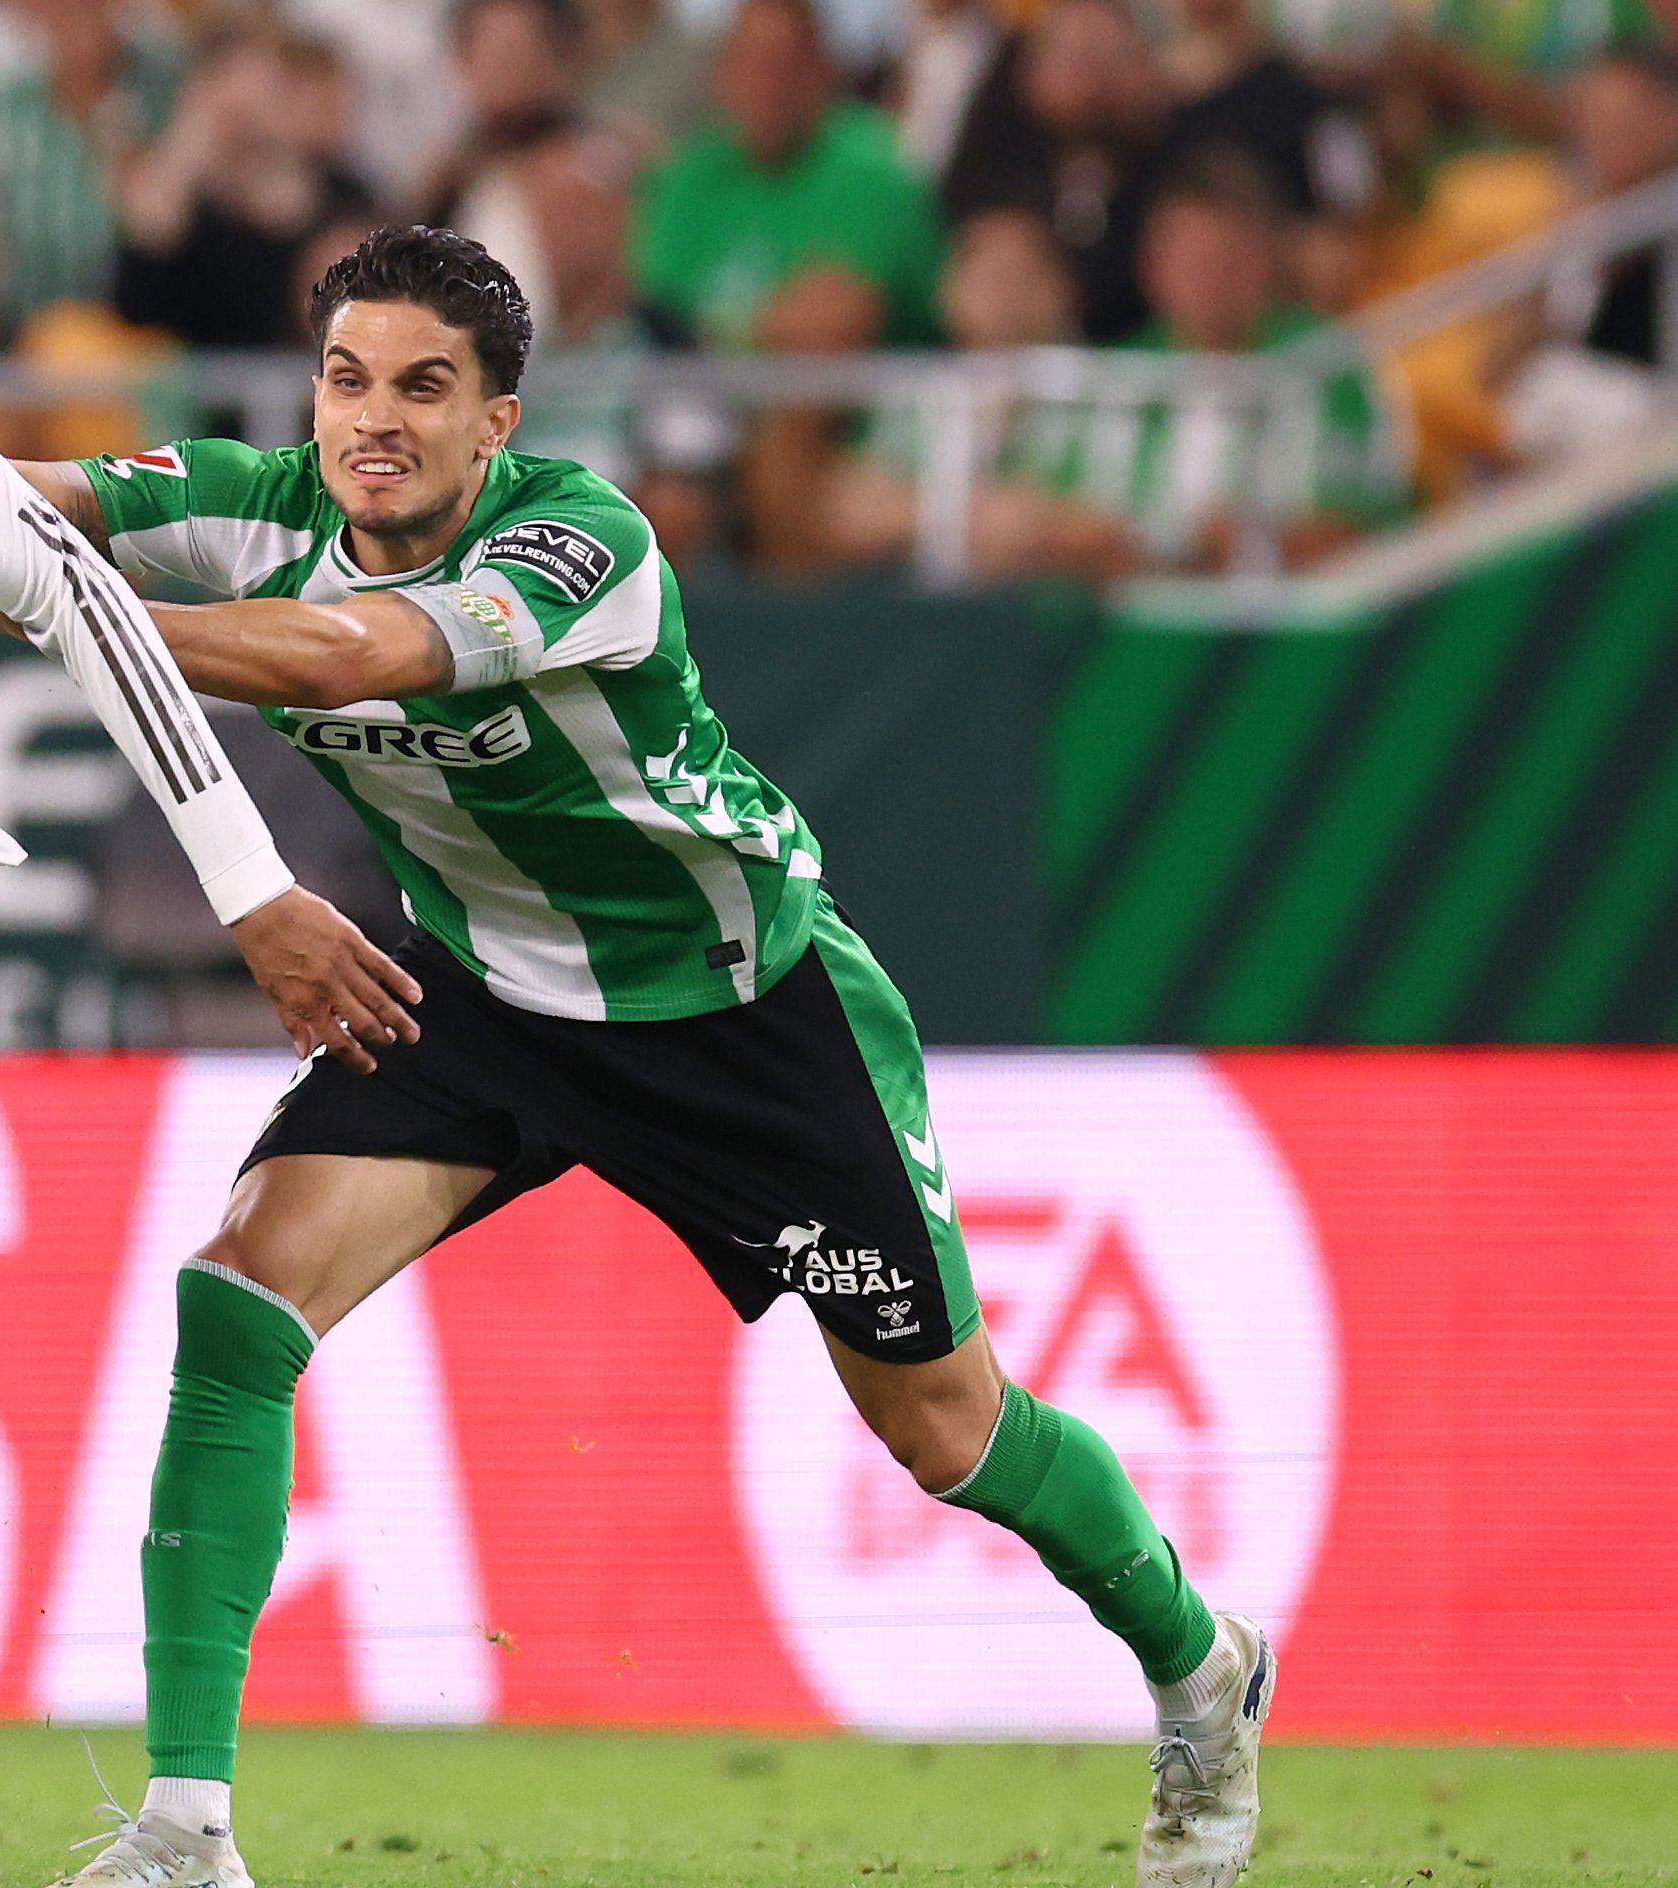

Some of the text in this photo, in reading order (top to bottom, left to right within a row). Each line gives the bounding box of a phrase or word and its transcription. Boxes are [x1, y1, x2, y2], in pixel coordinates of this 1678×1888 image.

[304, 713, 523, 763] GREE
[804, 1248, 883, 1273] AUS
[876, 1320, 921, 1341] hummel
